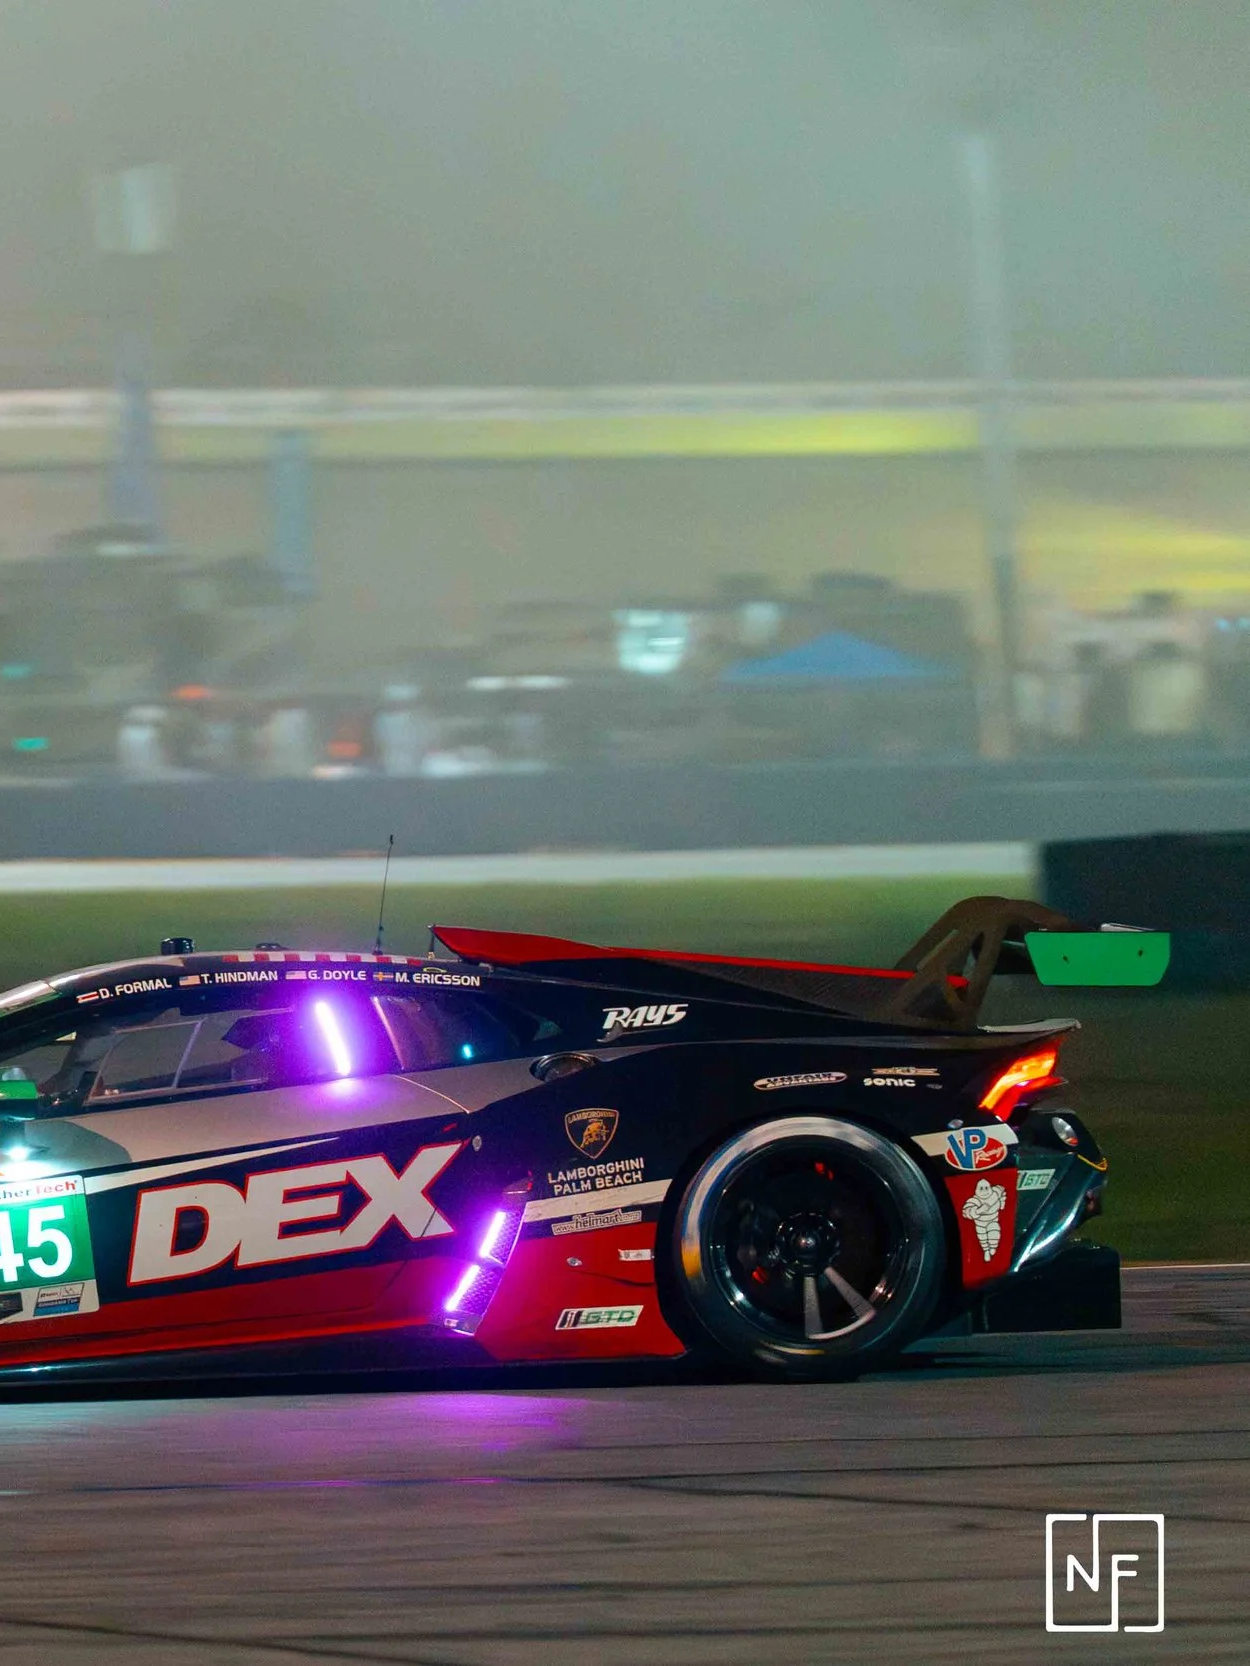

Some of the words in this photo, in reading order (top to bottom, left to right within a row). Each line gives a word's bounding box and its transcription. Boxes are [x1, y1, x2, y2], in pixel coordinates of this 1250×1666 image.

[200, 974, 213, 984] T.
[214, 970, 278, 984] HINDMAN
[307, 970, 320, 980] G.
[323, 969, 367, 981] DOYLE
[395, 972, 410, 983] M.
[412, 973, 481, 987] ERICSSON
[98, 988, 114, 999] D.
[115, 977, 172, 996] FORMAL
[602, 1003, 689, 1030] RAYS
[947, 1128, 987, 1169] VP
[547, 1157, 645, 1184] LAMBORGHINI
[553, 1179, 592, 1196] PALM
[595, 1170, 643, 1189] BEACH
[127, 1138, 470, 1287] DEX
[584, 1309, 635, 1325] GTD
